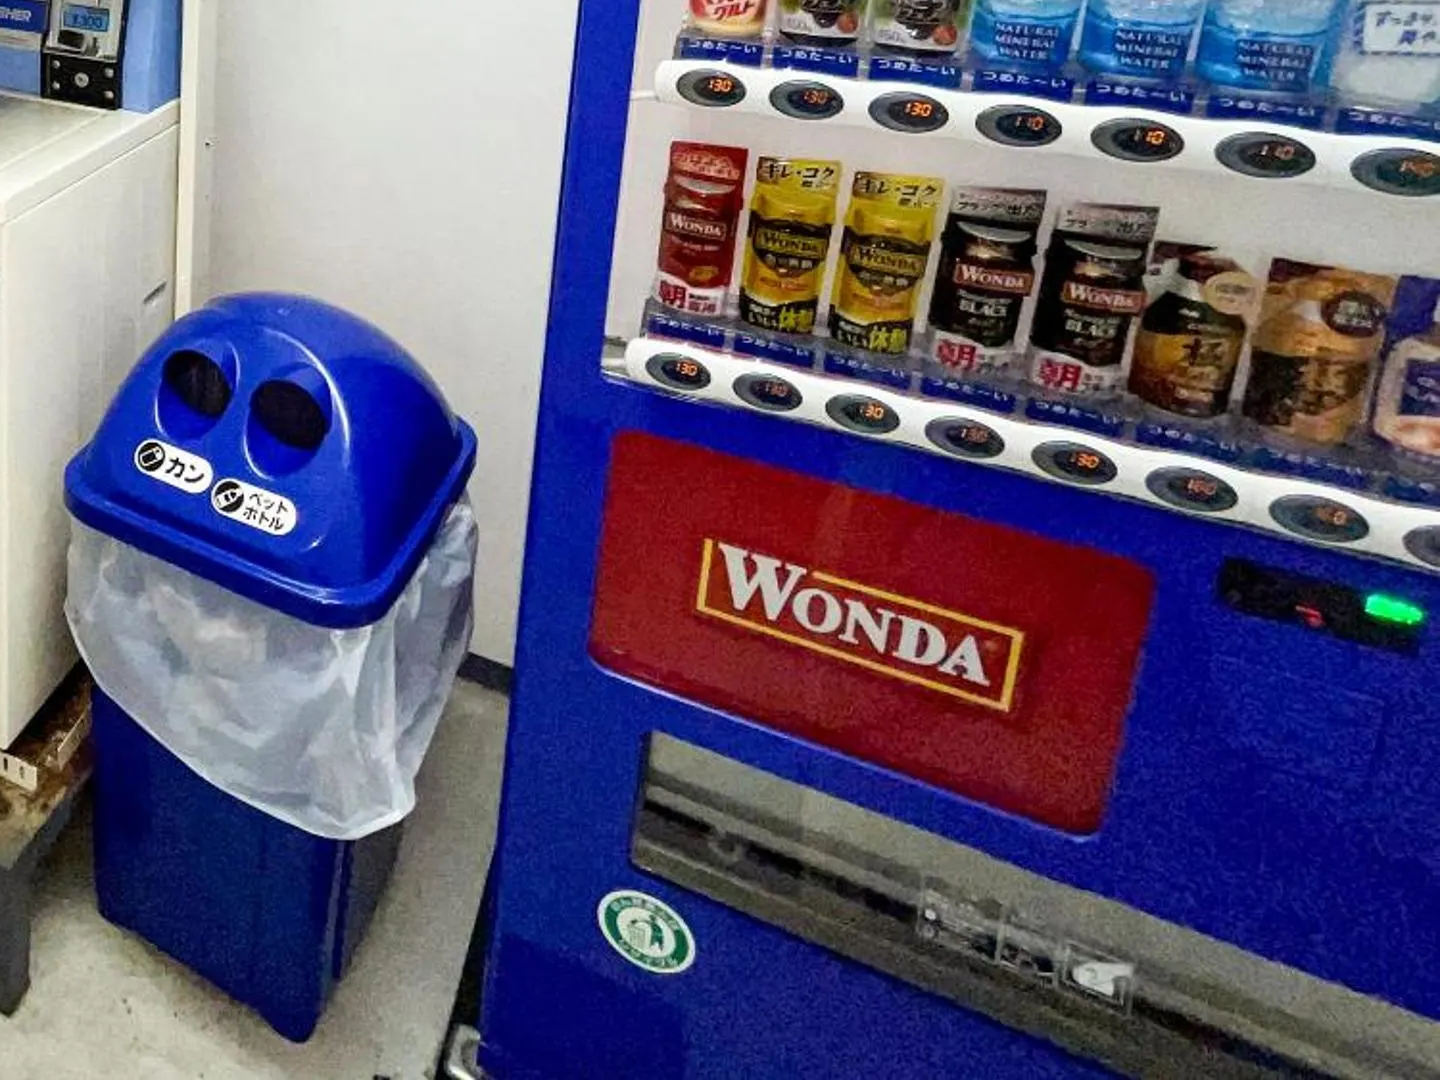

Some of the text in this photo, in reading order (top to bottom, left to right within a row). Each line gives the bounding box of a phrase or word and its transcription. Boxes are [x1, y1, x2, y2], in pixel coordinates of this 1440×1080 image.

[1244, 68, 1296, 81] WATER
[905, 102, 933, 117] 130
[670, 212, 722, 237] WONDA
[763, 230, 819, 253] WONDA
[959, 264, 1025, 289] WONDA
[1070, 283, 1135, 307] WONDA
[165, 457, 205, 483] カン
[248, 491, 288, 514] ペット
[243, 507, 285, 531] ボトル
[717, 541, 990, 687] WONDA
